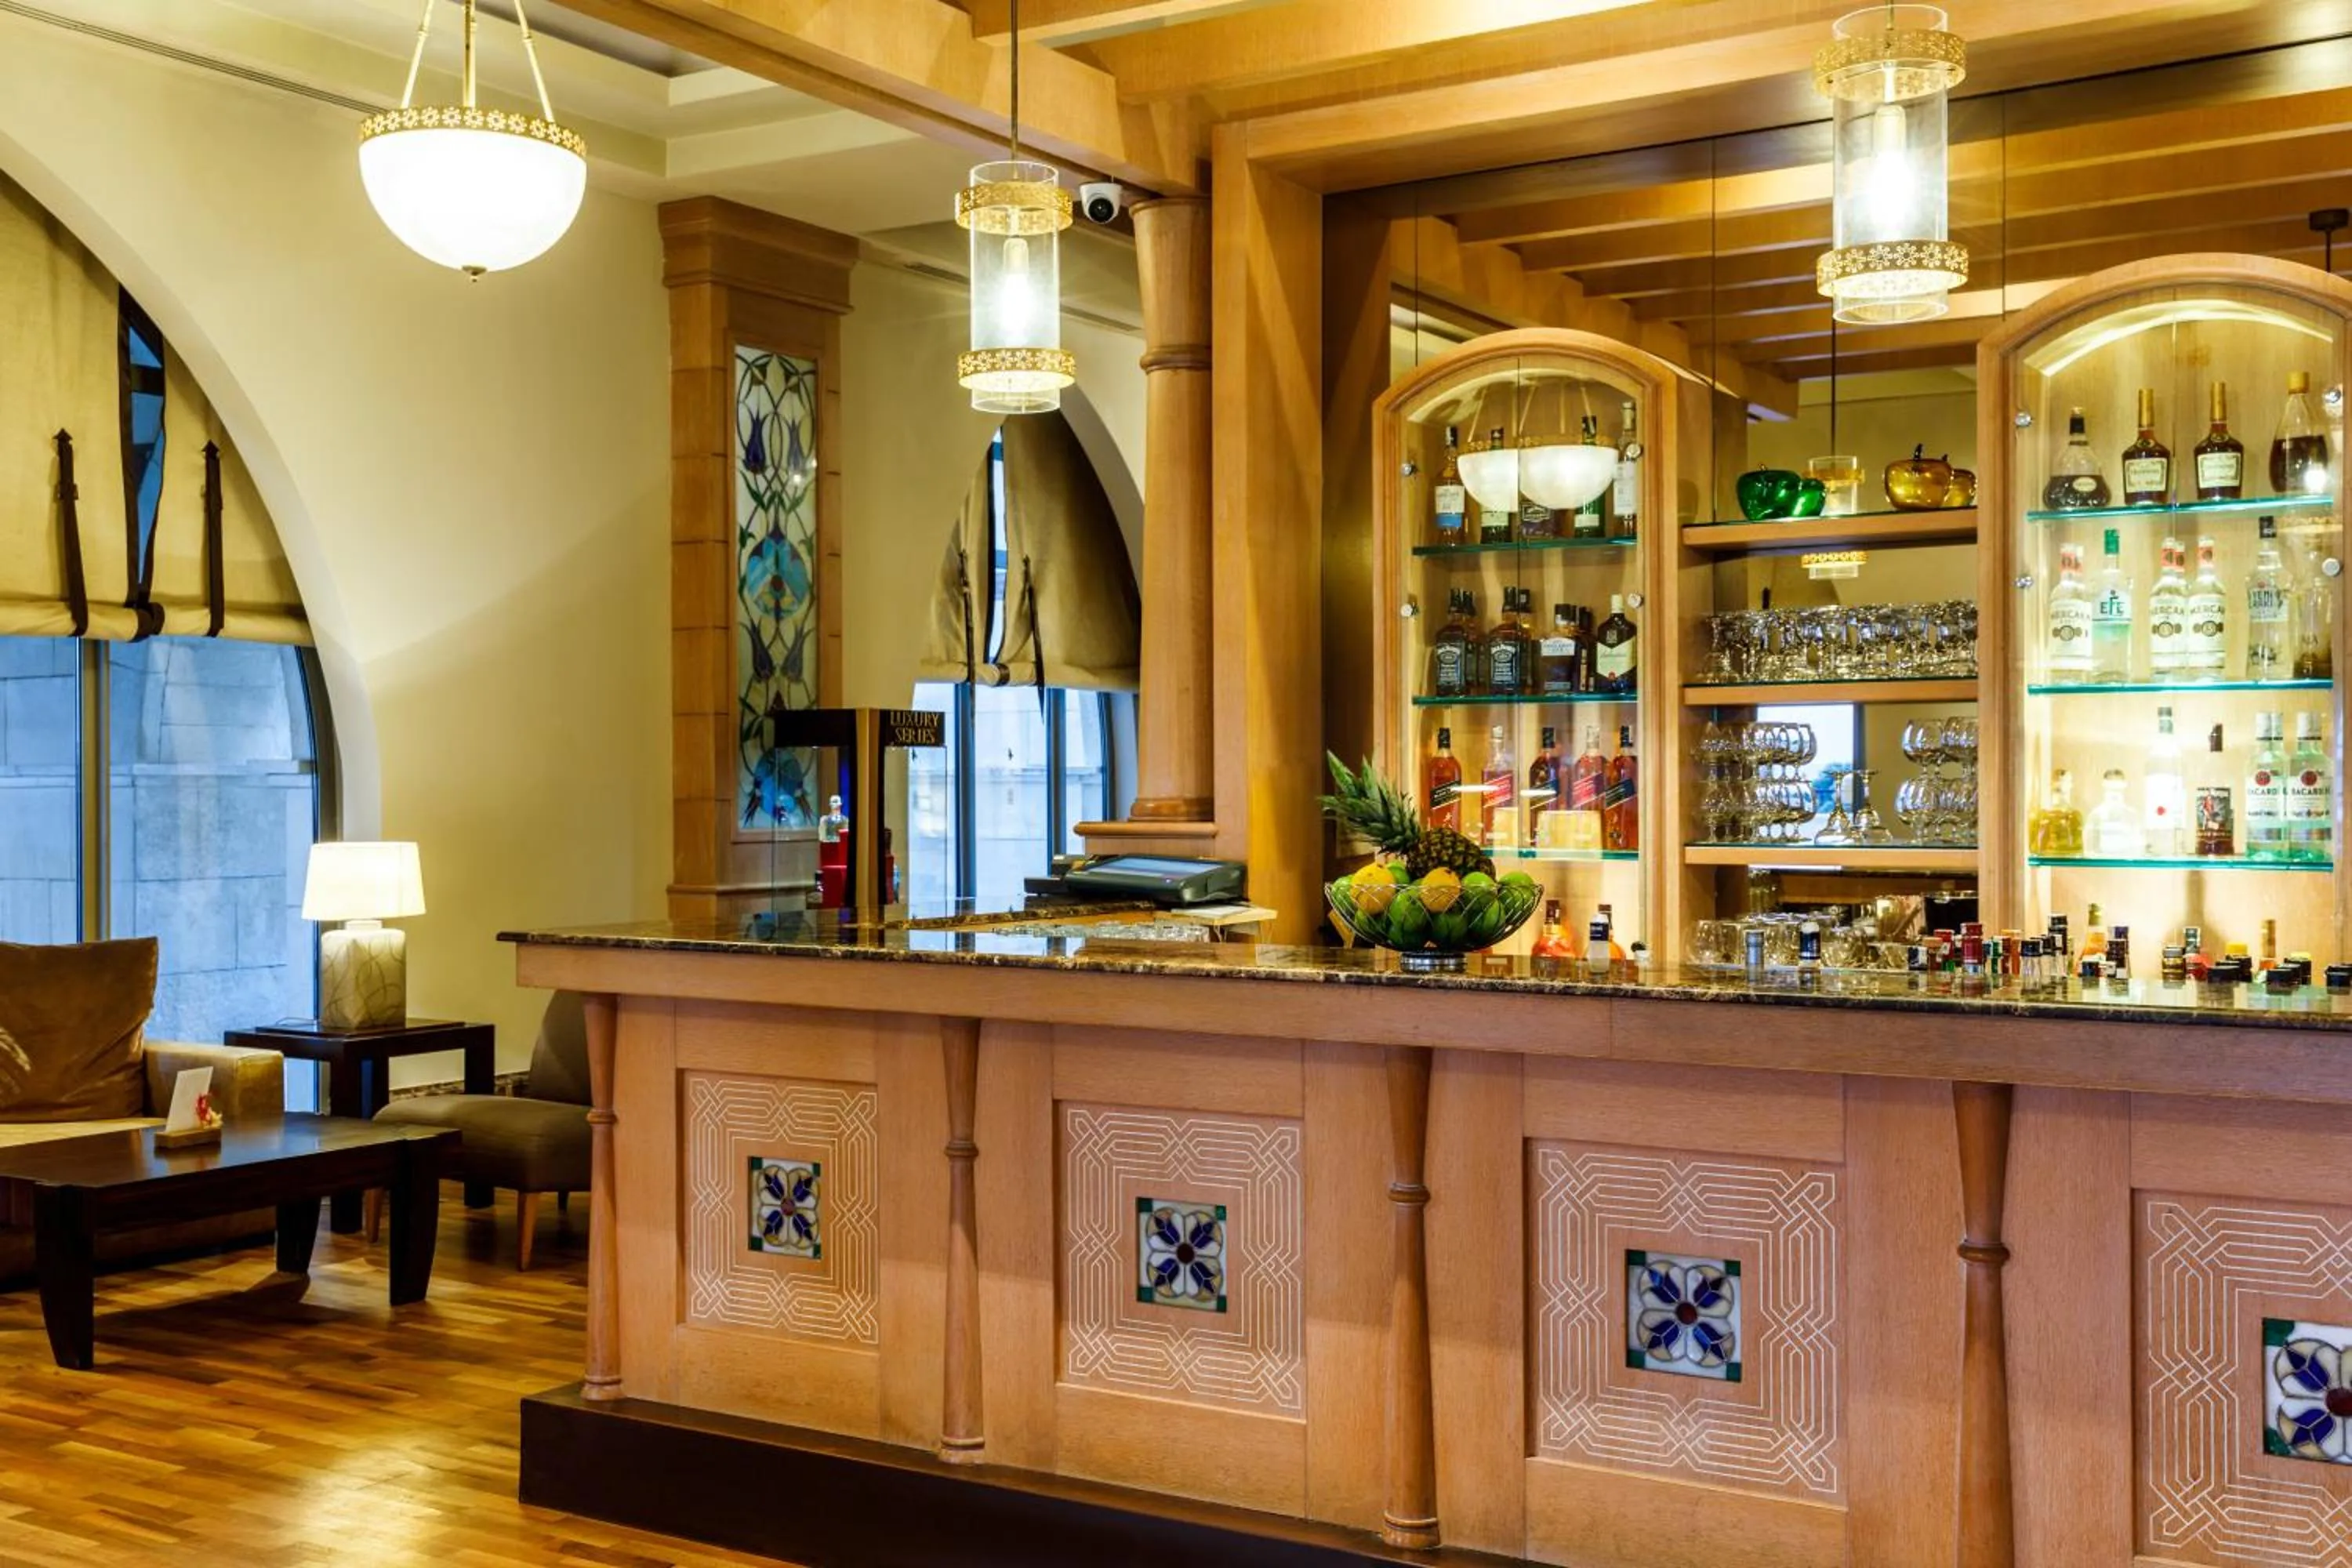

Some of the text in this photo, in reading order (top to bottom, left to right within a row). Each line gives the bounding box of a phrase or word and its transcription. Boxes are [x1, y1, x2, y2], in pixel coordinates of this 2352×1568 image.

[2099, 596, 2125, 615] EFE
[890, 711, 938, 728] LUXURY
[895, 727, 935, 744] SERIES
